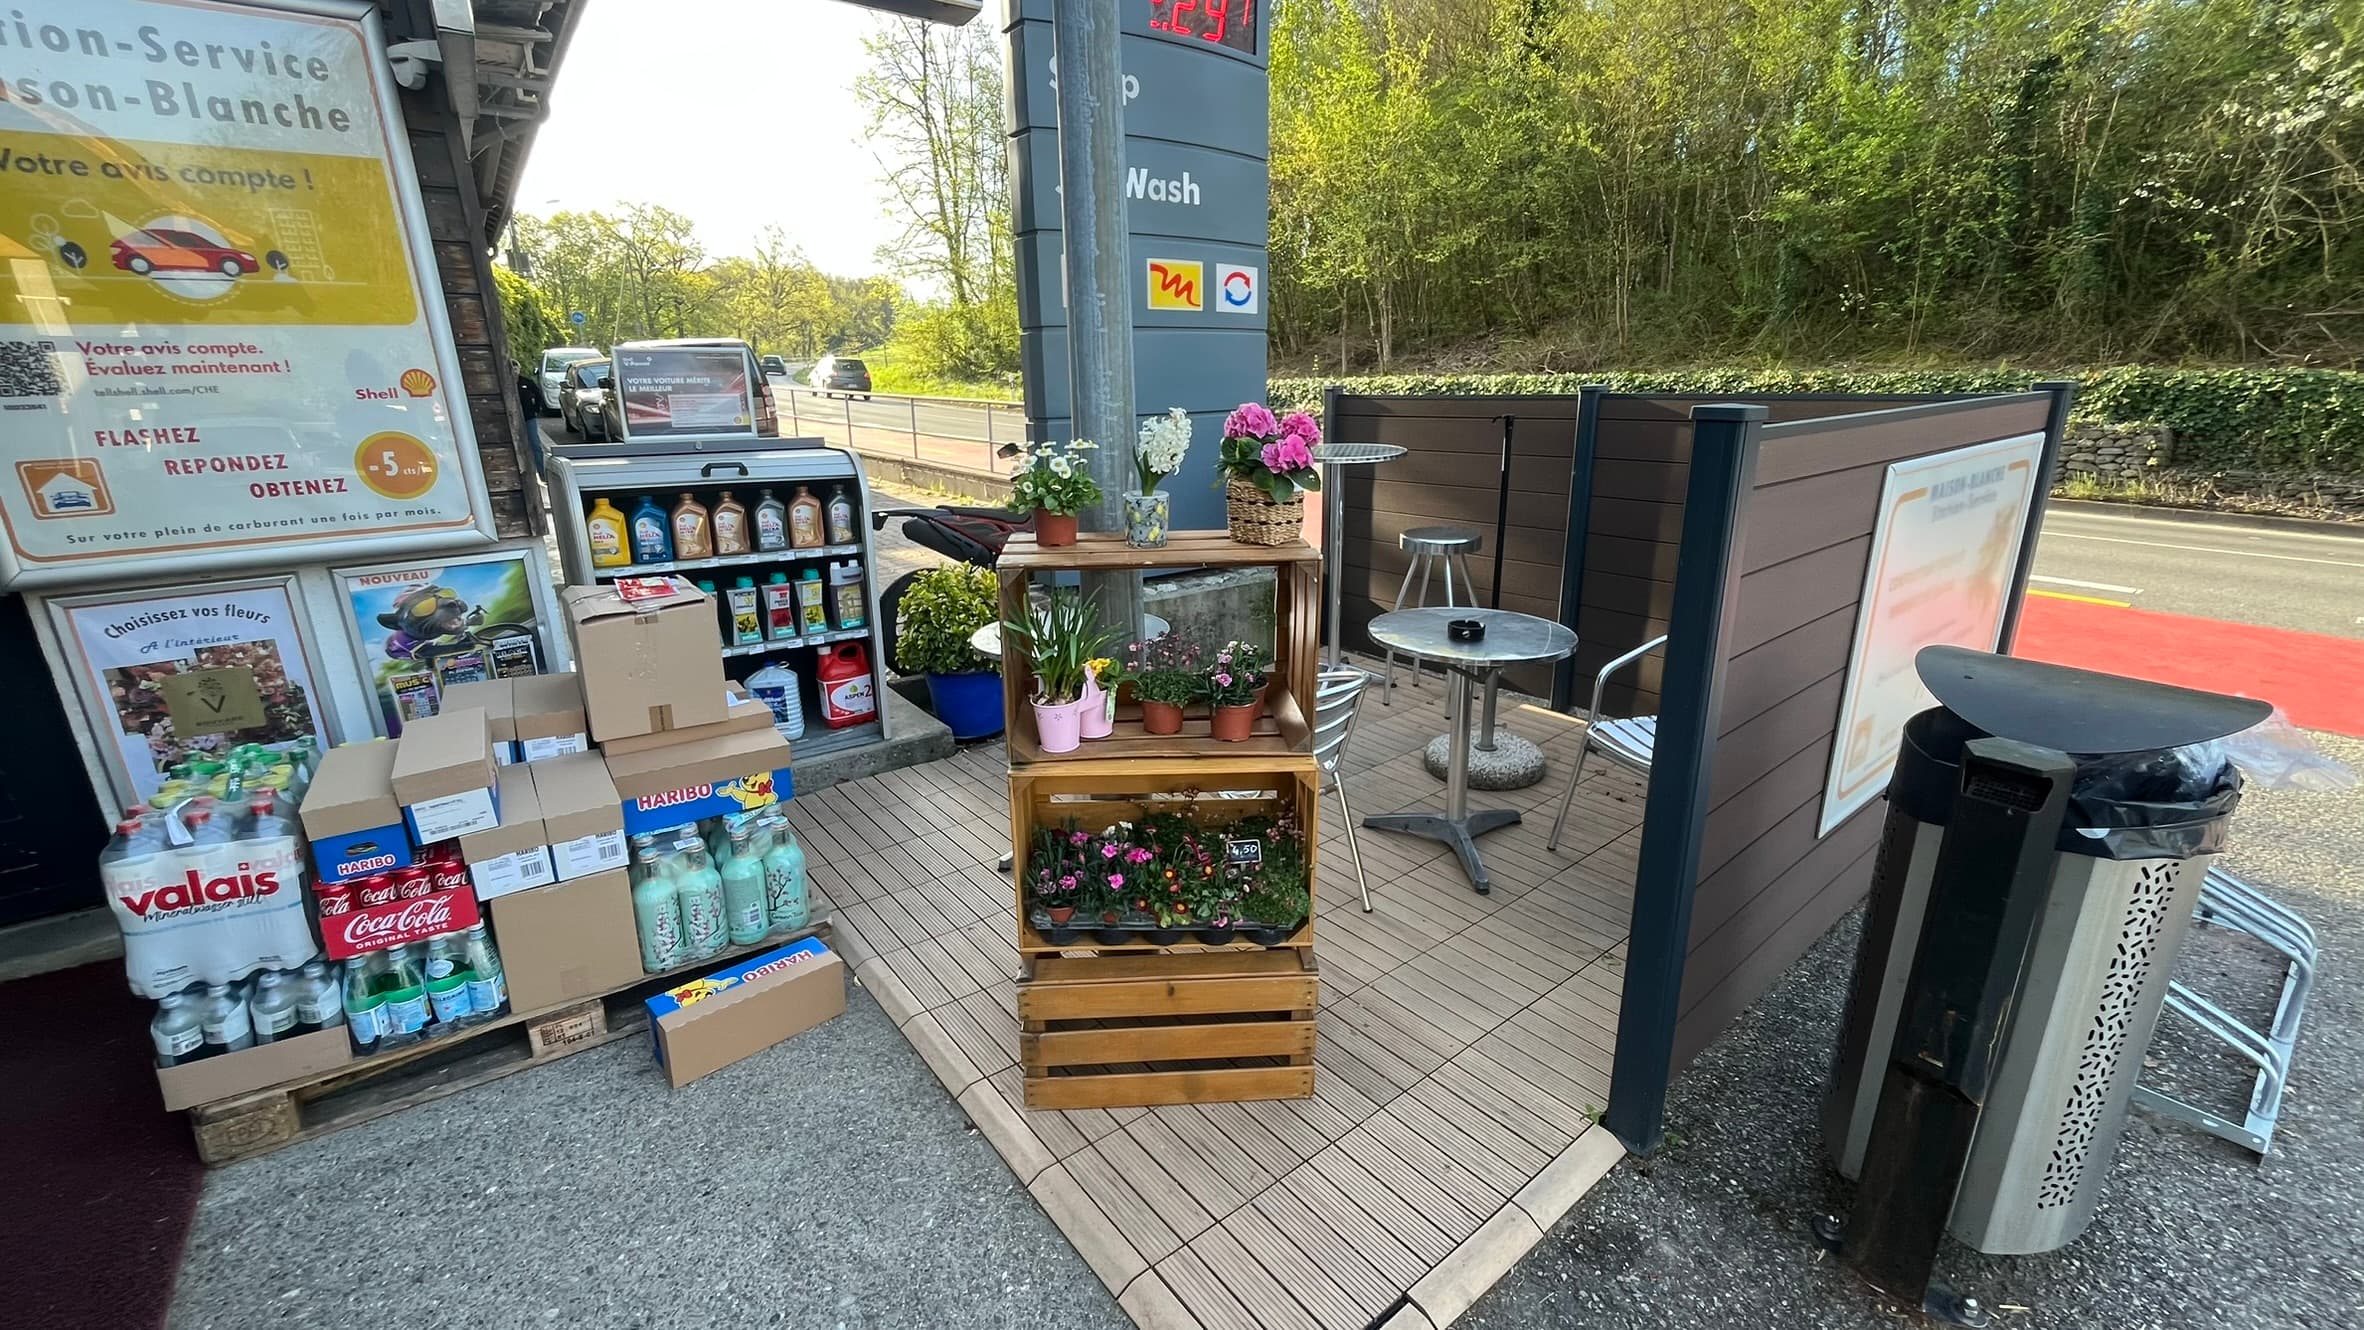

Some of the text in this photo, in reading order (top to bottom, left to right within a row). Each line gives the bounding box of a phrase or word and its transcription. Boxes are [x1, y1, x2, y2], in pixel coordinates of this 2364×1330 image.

[101, 160, 170, 182] avis
[178, 163, 297, 193] compte
[304, 168, 314, 191] !
[75, 340, 264, 358] Votre avis compte.
[86, 357, 292, 376] Évaluez maintenant !
[627, 377, 652, 385] VOTRE
[655, 377, 684, 385] VOITURE
[629, 385, 673, 393] LE MEILLEUR
[355, 387, 399, 400] Shell
[94, 427, 201, 448] FLASHEZ
[164, 453, 289, 476] REPONDEZ
[249, 477, 348, 499] OBTENEZ
[66, 507, 442, 545] Sur votre plein de carburant une fois par mois.
[360, 571, 429, 586] NOUVEAU
[104, 603, 271, 639] Choisissez vos fleurs
[140, 640, 159, 654] A
[863, 684, 873, 699] 2
[636, 782, 713, 812] HARIBO
[337, 854, 396, 876] HARIBO
[119, 862, 280, 917] valais
[143, 893, 264, 924] Mineralwasser still
[344, 894, 454, 944] Coca-Cola
[355, 922, 449, 950] ORIGINAL TASTE
[742, 949, 815, 983] HARIBO
